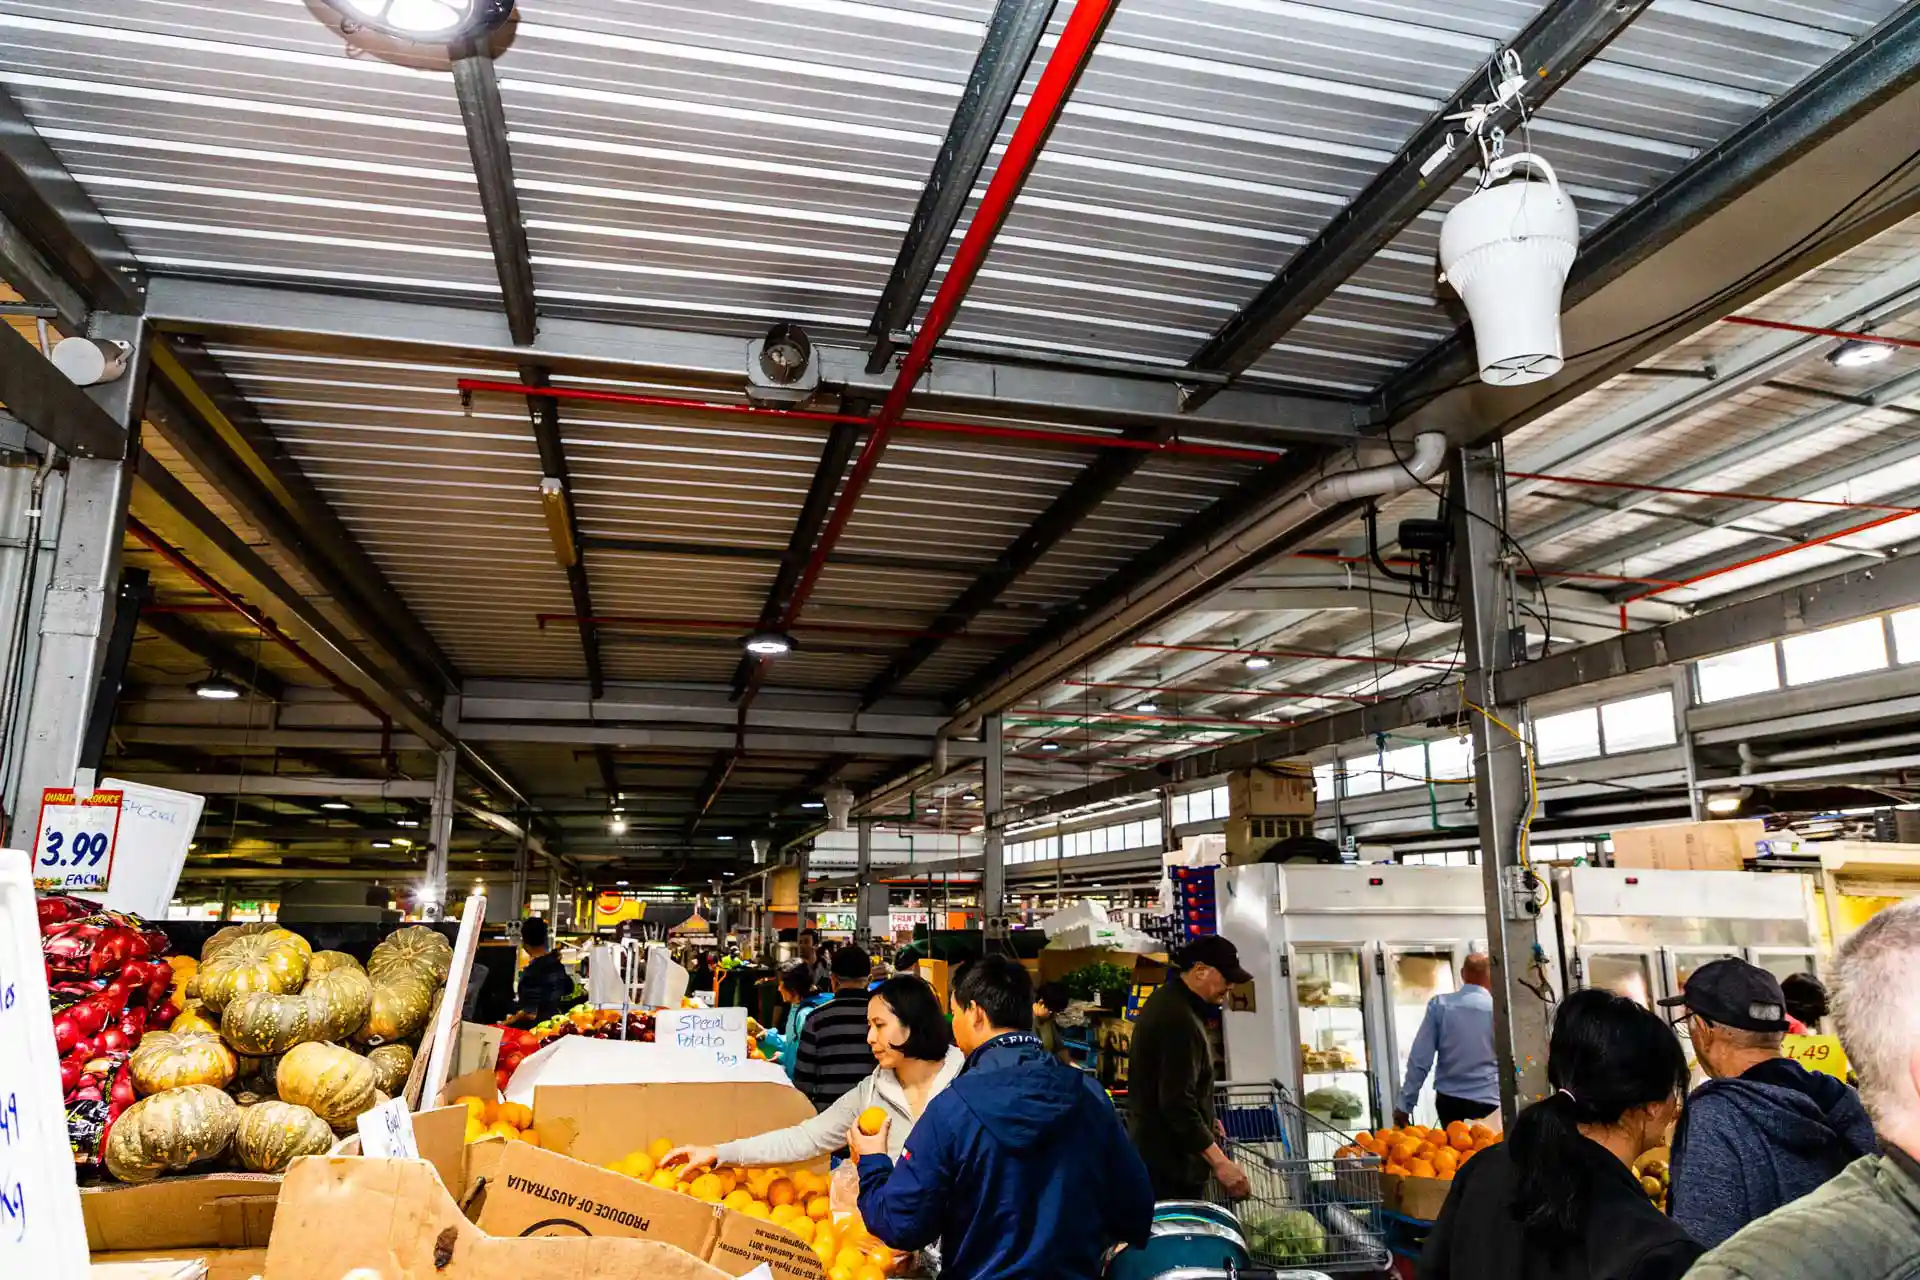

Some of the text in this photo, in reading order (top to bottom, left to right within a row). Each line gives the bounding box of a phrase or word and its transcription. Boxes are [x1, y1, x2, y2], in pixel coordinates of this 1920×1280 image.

[65, 873, 98, 886] EACH
[507, 1174, 650, 1232] PRODUCE OF AUSTRALIA
[747, 1239, 765, 1251] 3011
[764, 1243, 794, 1260] Australia
